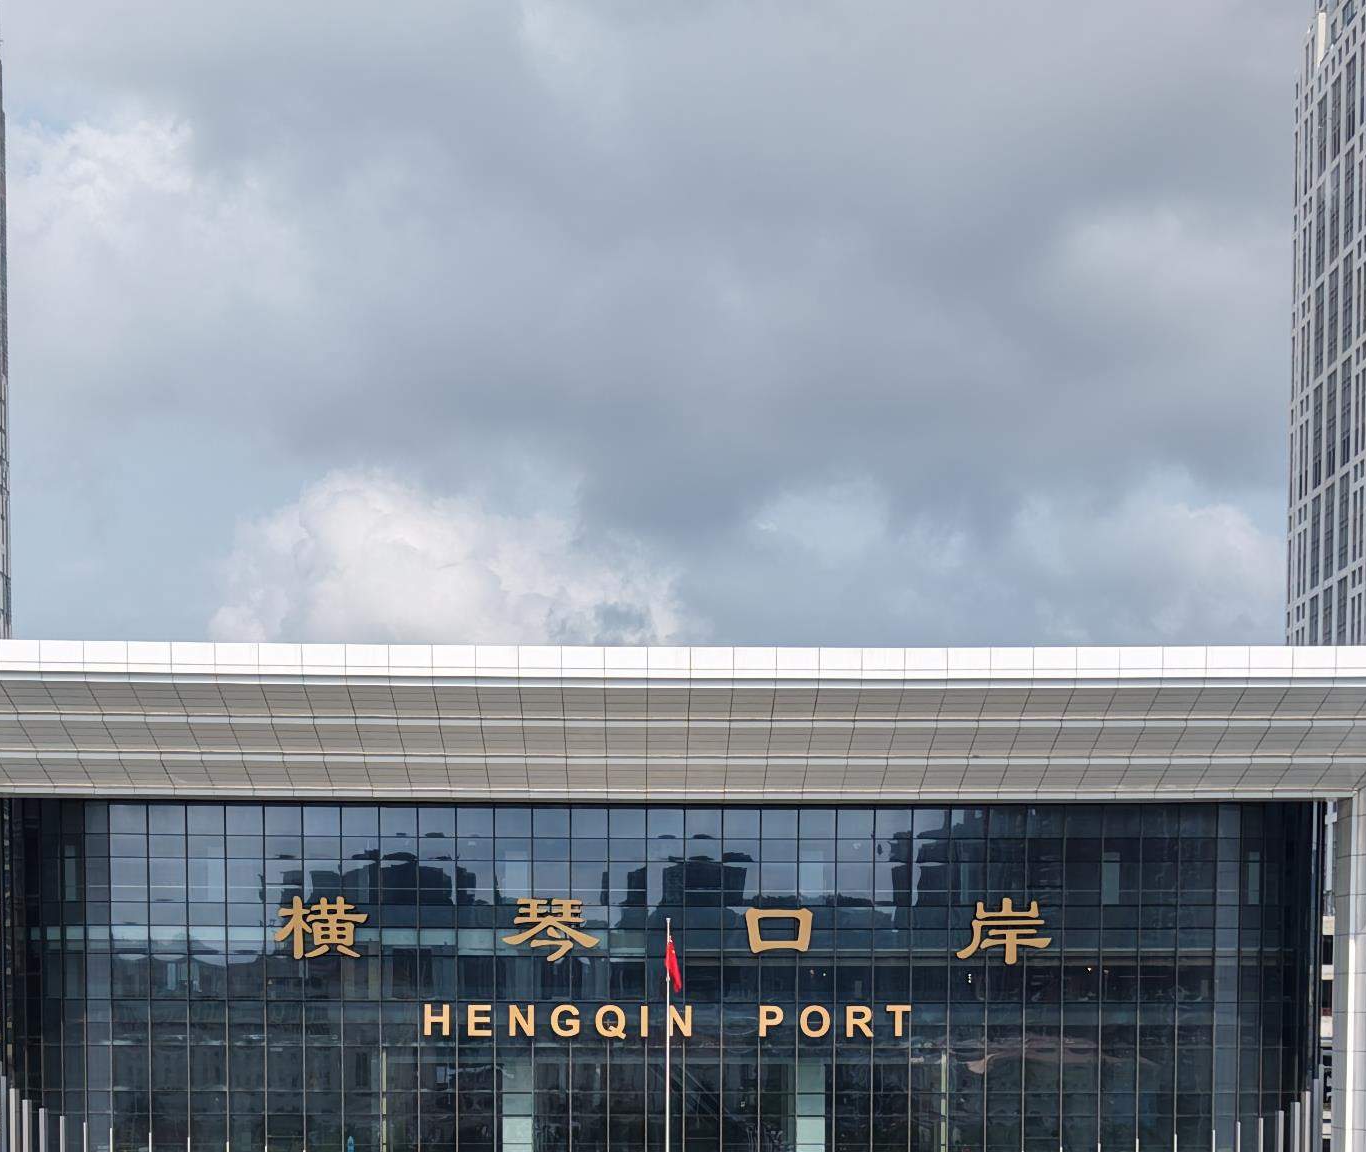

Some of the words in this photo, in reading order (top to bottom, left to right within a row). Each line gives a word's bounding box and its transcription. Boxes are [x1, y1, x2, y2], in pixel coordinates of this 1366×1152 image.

[274, 896, 1052, 965] 横琴口岸
[422, 1003, 693, 1040] HENGQIN
[758, 1003, 912, 1038] PORT
